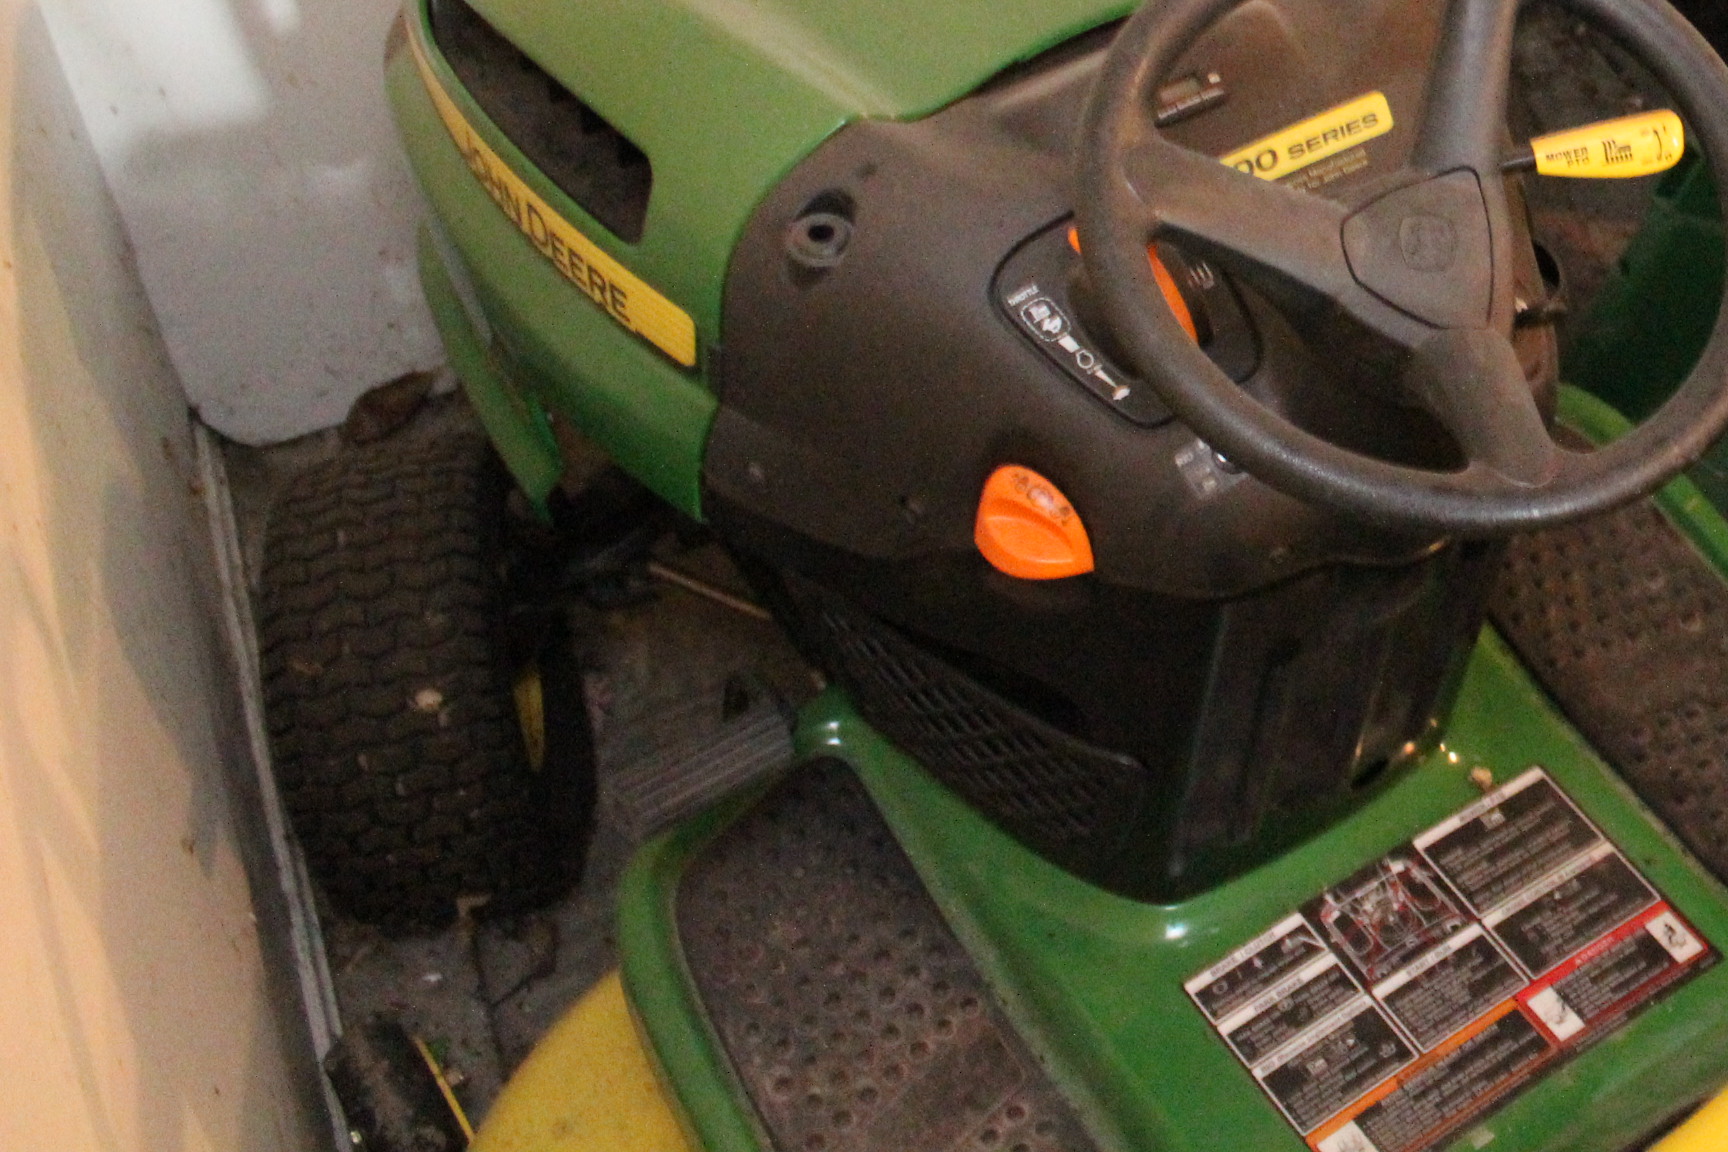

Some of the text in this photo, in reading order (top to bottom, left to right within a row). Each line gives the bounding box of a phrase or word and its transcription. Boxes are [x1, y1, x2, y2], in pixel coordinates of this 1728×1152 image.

[1288, 112, 1379, 161] SERIES
[1545, 146, 1589, 161] MOWER
[526, 201, 631, 324] DEERE
